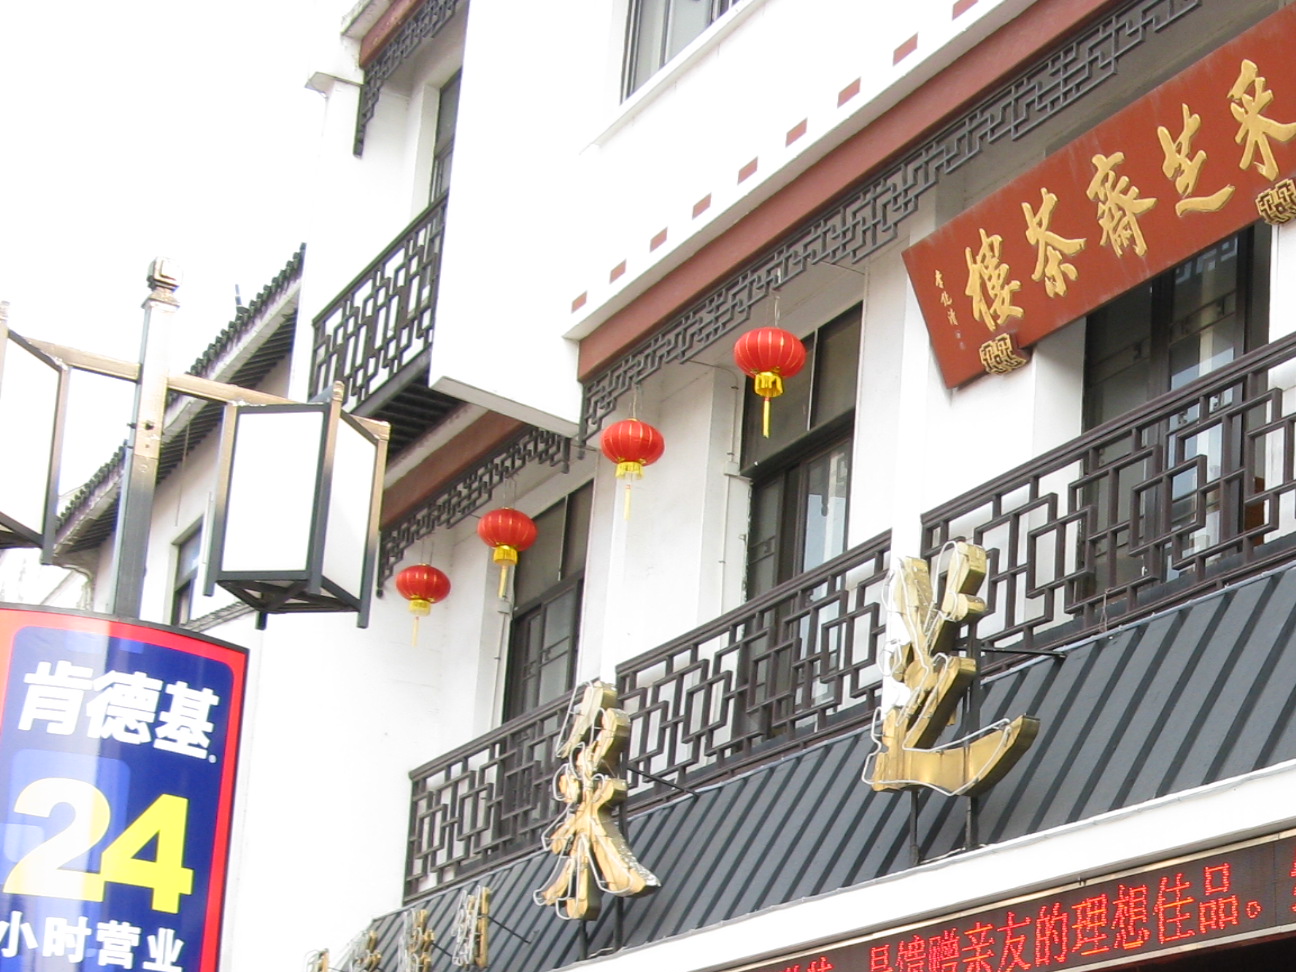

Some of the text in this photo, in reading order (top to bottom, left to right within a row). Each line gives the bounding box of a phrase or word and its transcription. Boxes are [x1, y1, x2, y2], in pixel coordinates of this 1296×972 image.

[18, 661, 220, 760] 肯德基
[3, 777, 195, 915] 24
